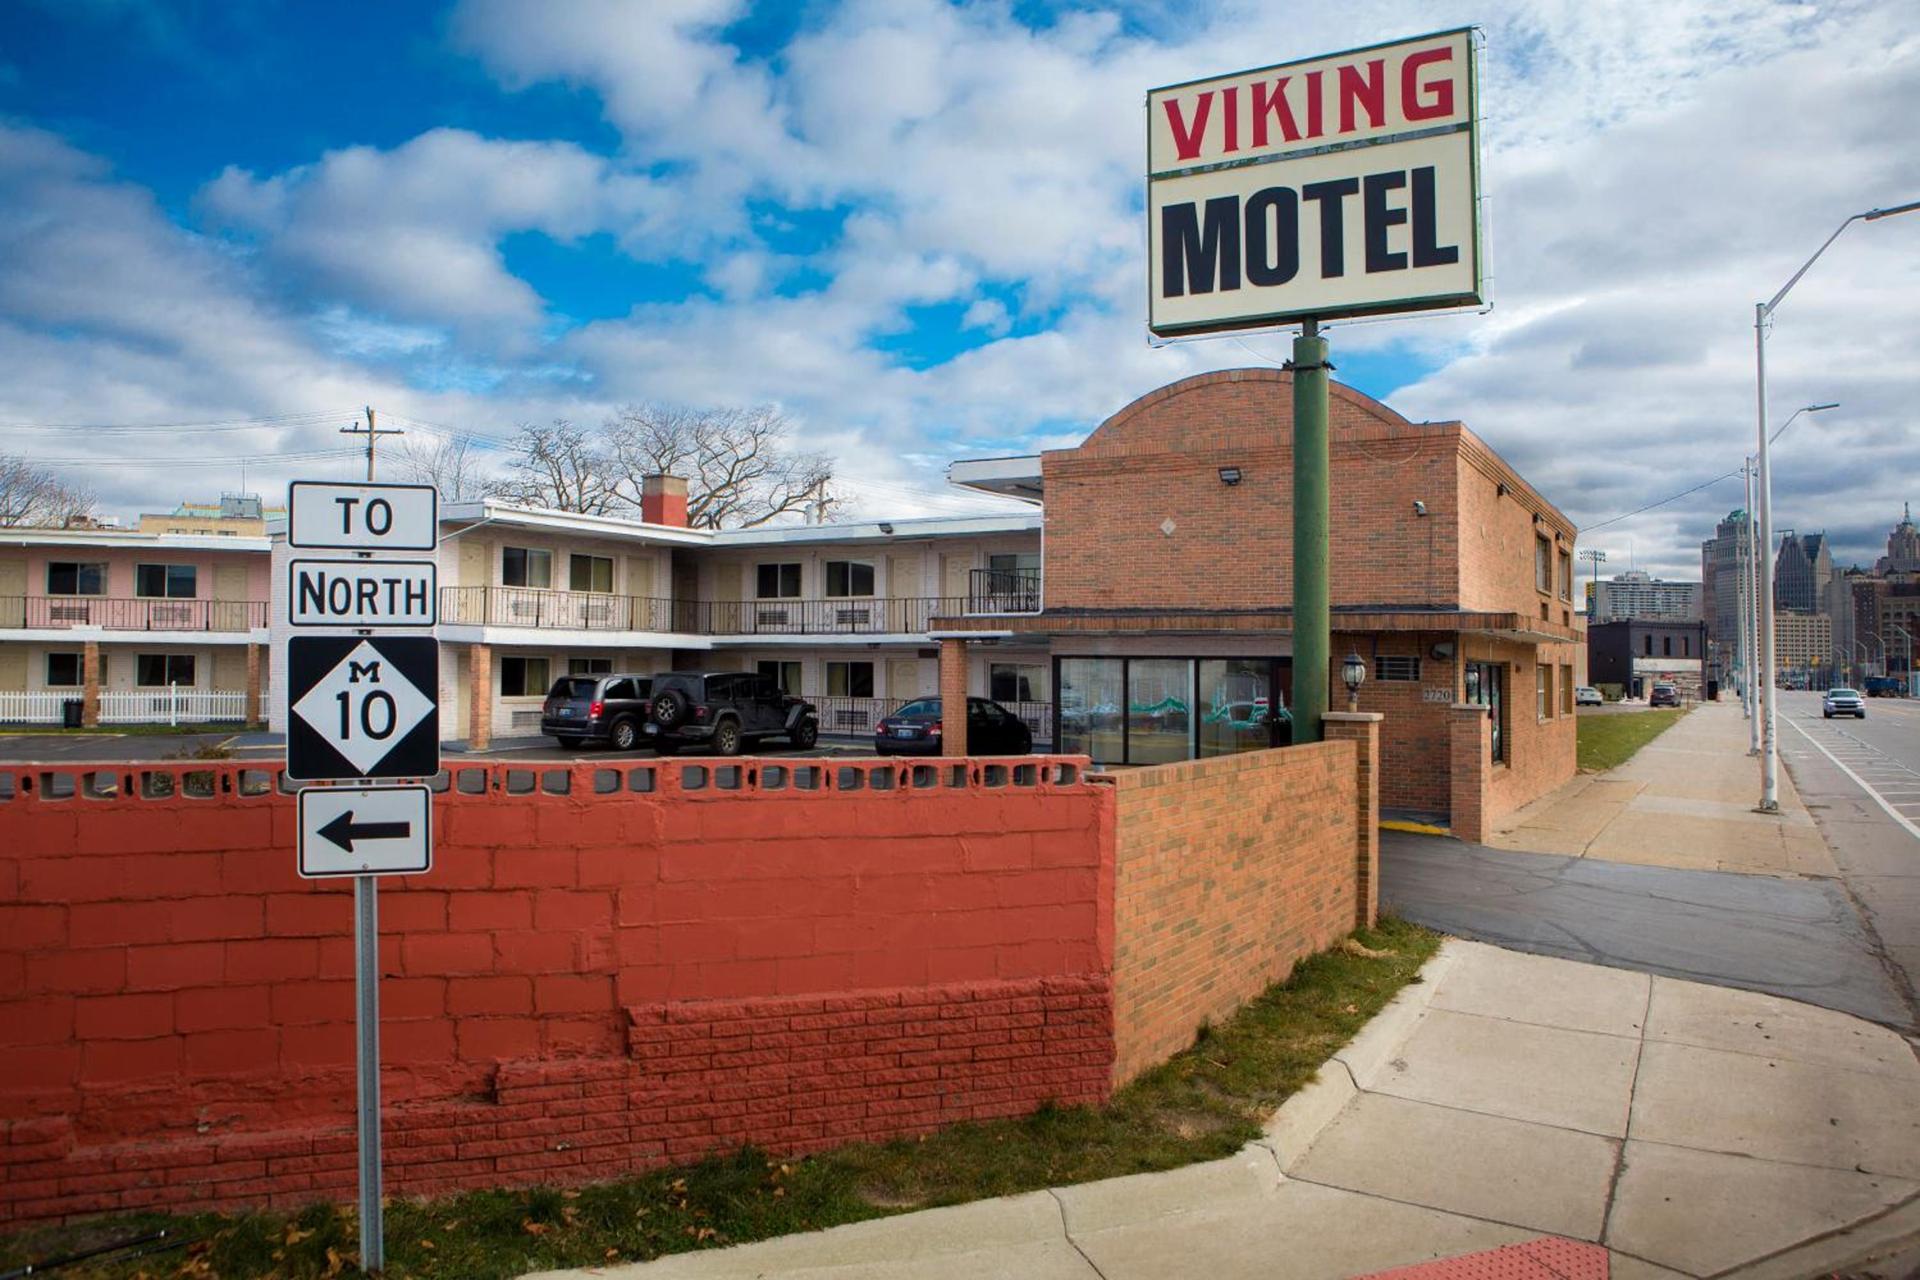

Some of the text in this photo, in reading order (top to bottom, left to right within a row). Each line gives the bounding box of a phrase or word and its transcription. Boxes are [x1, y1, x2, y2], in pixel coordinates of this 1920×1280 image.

[1162, 46, 1454, 161] VIKING
[1162, 165, 1459, 298] MOTEL
[335, 497, 393, 536] TO
[299, 571, 428, 616] NORTH
[348, 661, 381, 683] M
[335, 690, 397, 740] 10
